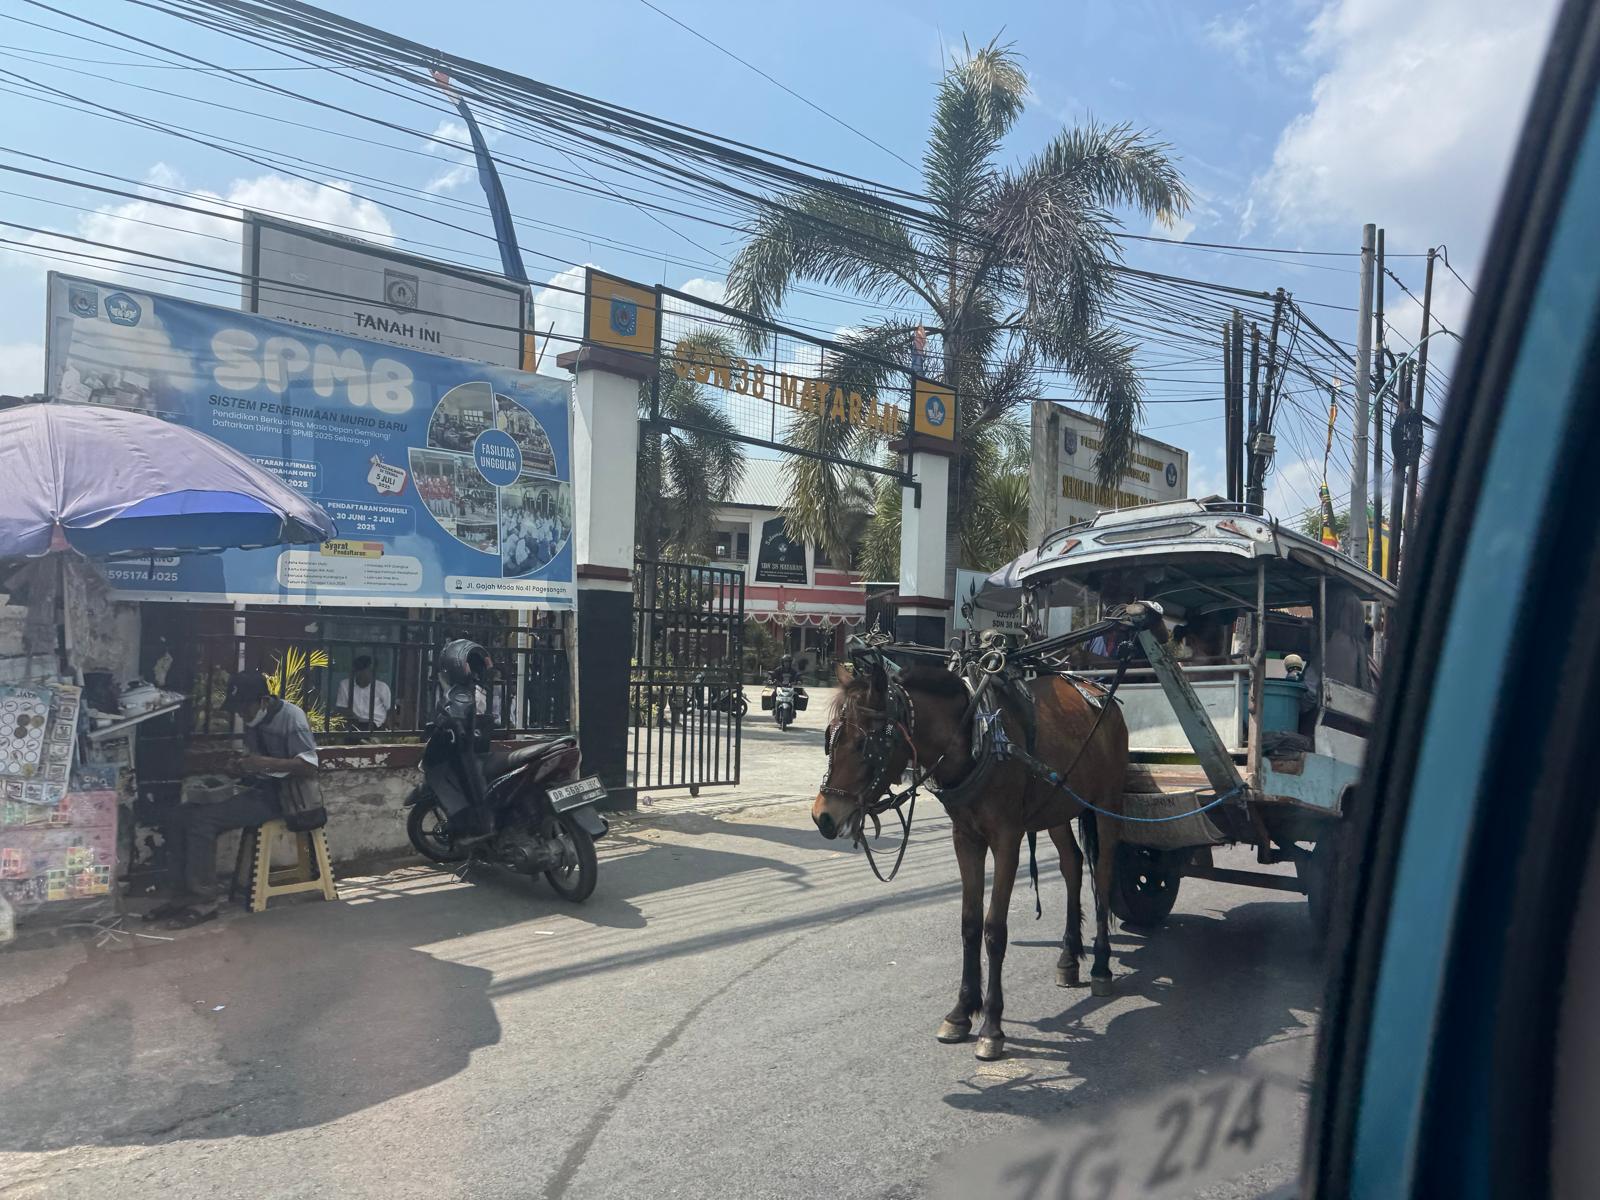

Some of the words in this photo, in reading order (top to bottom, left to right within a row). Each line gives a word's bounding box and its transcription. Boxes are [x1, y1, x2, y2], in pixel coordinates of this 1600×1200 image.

[354, 312, 414, 338] TANAH
[419, 328, 441, 344] INI
[210, 328, 414, 415] SPMB
[673, 341, 731, 389] SDN
[735, 358, 765, 399] 38
[780, 371, 899, 434] MATARAM
[208, 394, 257, 411] SISTEM
[259, 402, 337, 422] PENERIMAAN
[340, 414, 376, 427] MURID
[378, 421, 408, 432] BARU
[212, 409, 259, 422] Pendidikan
[306, 422, 327, 431] Masa
[328, 425, 353, 436] Depan
[212, 418, 255, 430] Daftarkan
[255, 423, 282, 433] Dirimu
[292, 429, 313, 438] SPMB
[315, 432, 334, 441] 2025
[334, 434, 371, 447] Sekarang!
[481, 443, 515, 458] FASILITAS
[480, 456, 517, 471] UNGGULAN
[381, 475, 396, 486] JULI
[327, 502, 378, 512] PENDAFTARAN
[378, 506, 408, 515] DOMISILI
[347, 513, 366, 521] JUNI
[378, 516, 395, 524] JULI
[356, 523, 376, 531] 2025
[324, 541, 349, 551] Syarat
[466, 582, 475, 590] Jl.
[475, 583, 496, 591] Gajah
[497, 583, 515, 591] Mada
[532, 586, 567, 595] Pagesangan
